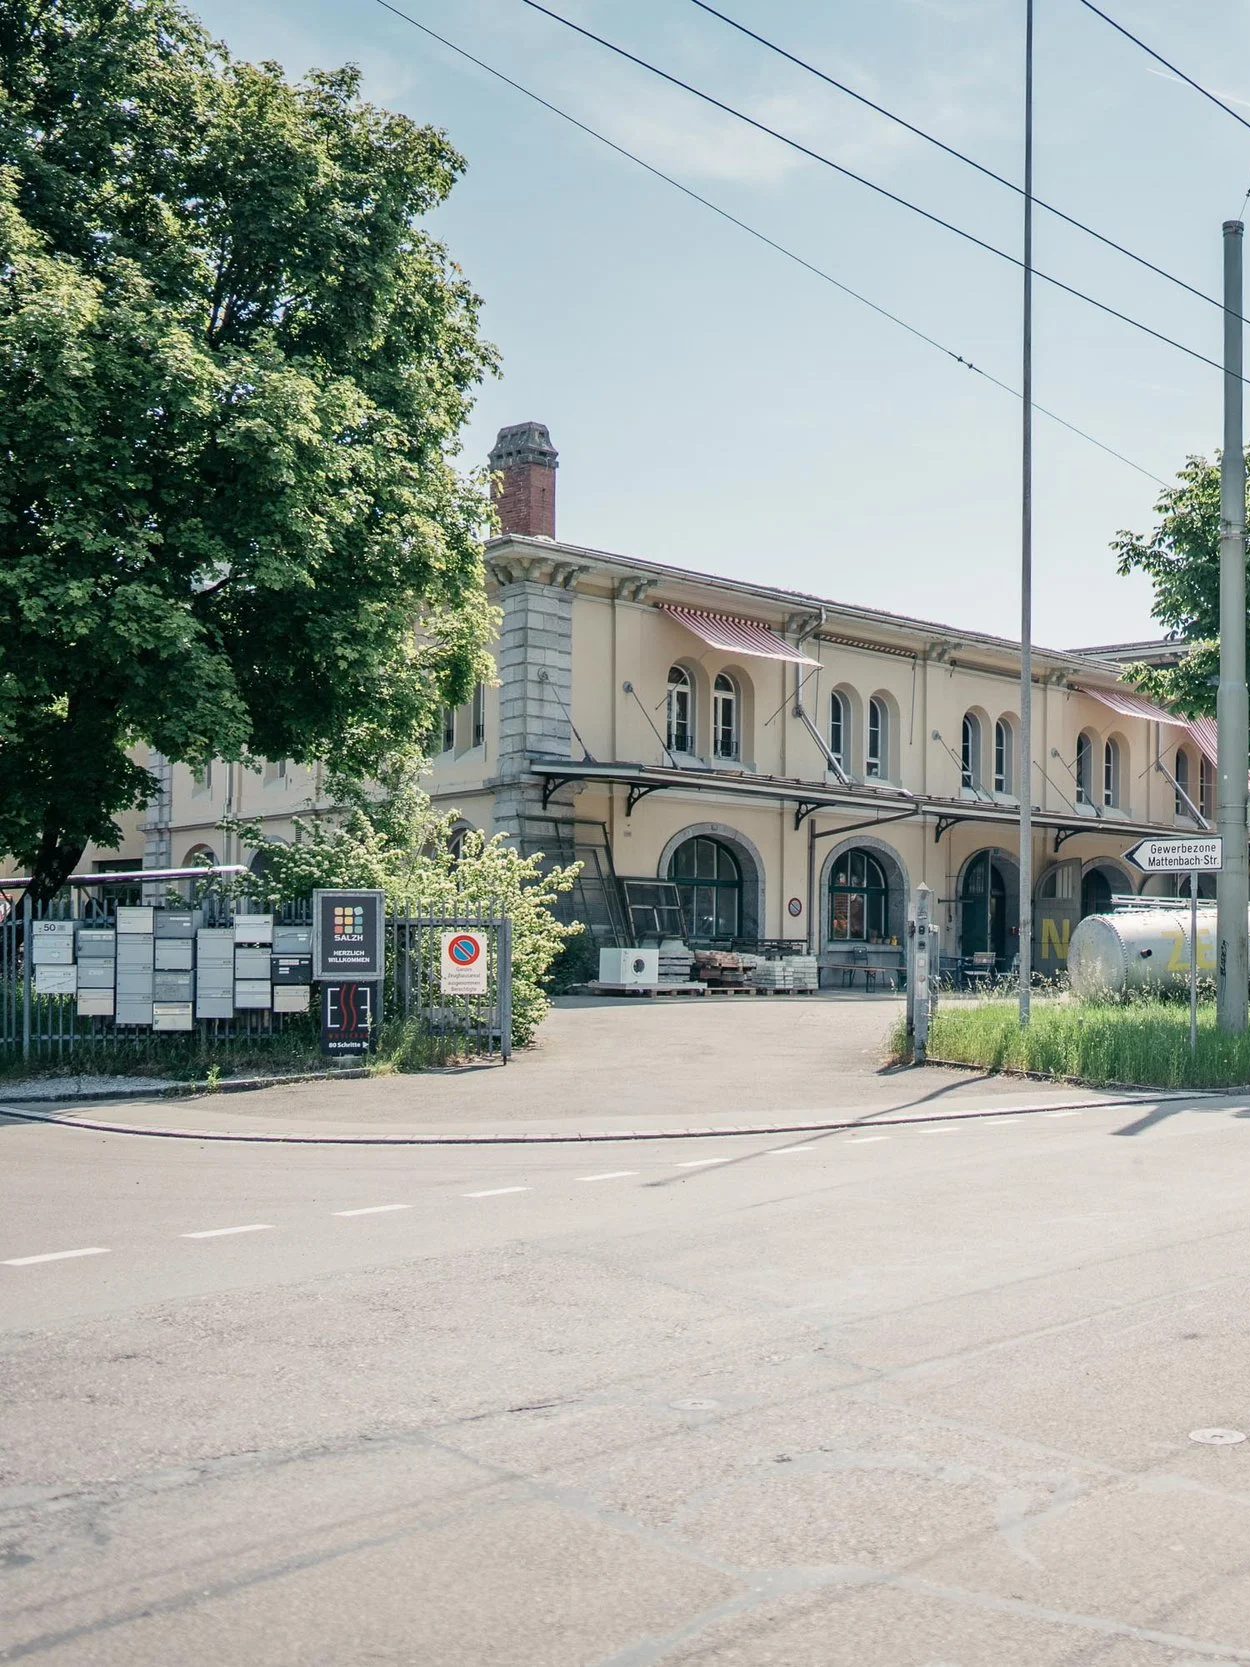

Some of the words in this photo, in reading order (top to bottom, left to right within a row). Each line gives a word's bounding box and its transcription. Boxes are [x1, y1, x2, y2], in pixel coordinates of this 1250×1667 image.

[1150, 843, 1217, 855] Gewerbezone
[1148, 854, 1220, 867] Mattenbach-Str.
[43, 923, 56, 932] 50
[334, 934, 364, 942] SALZH
